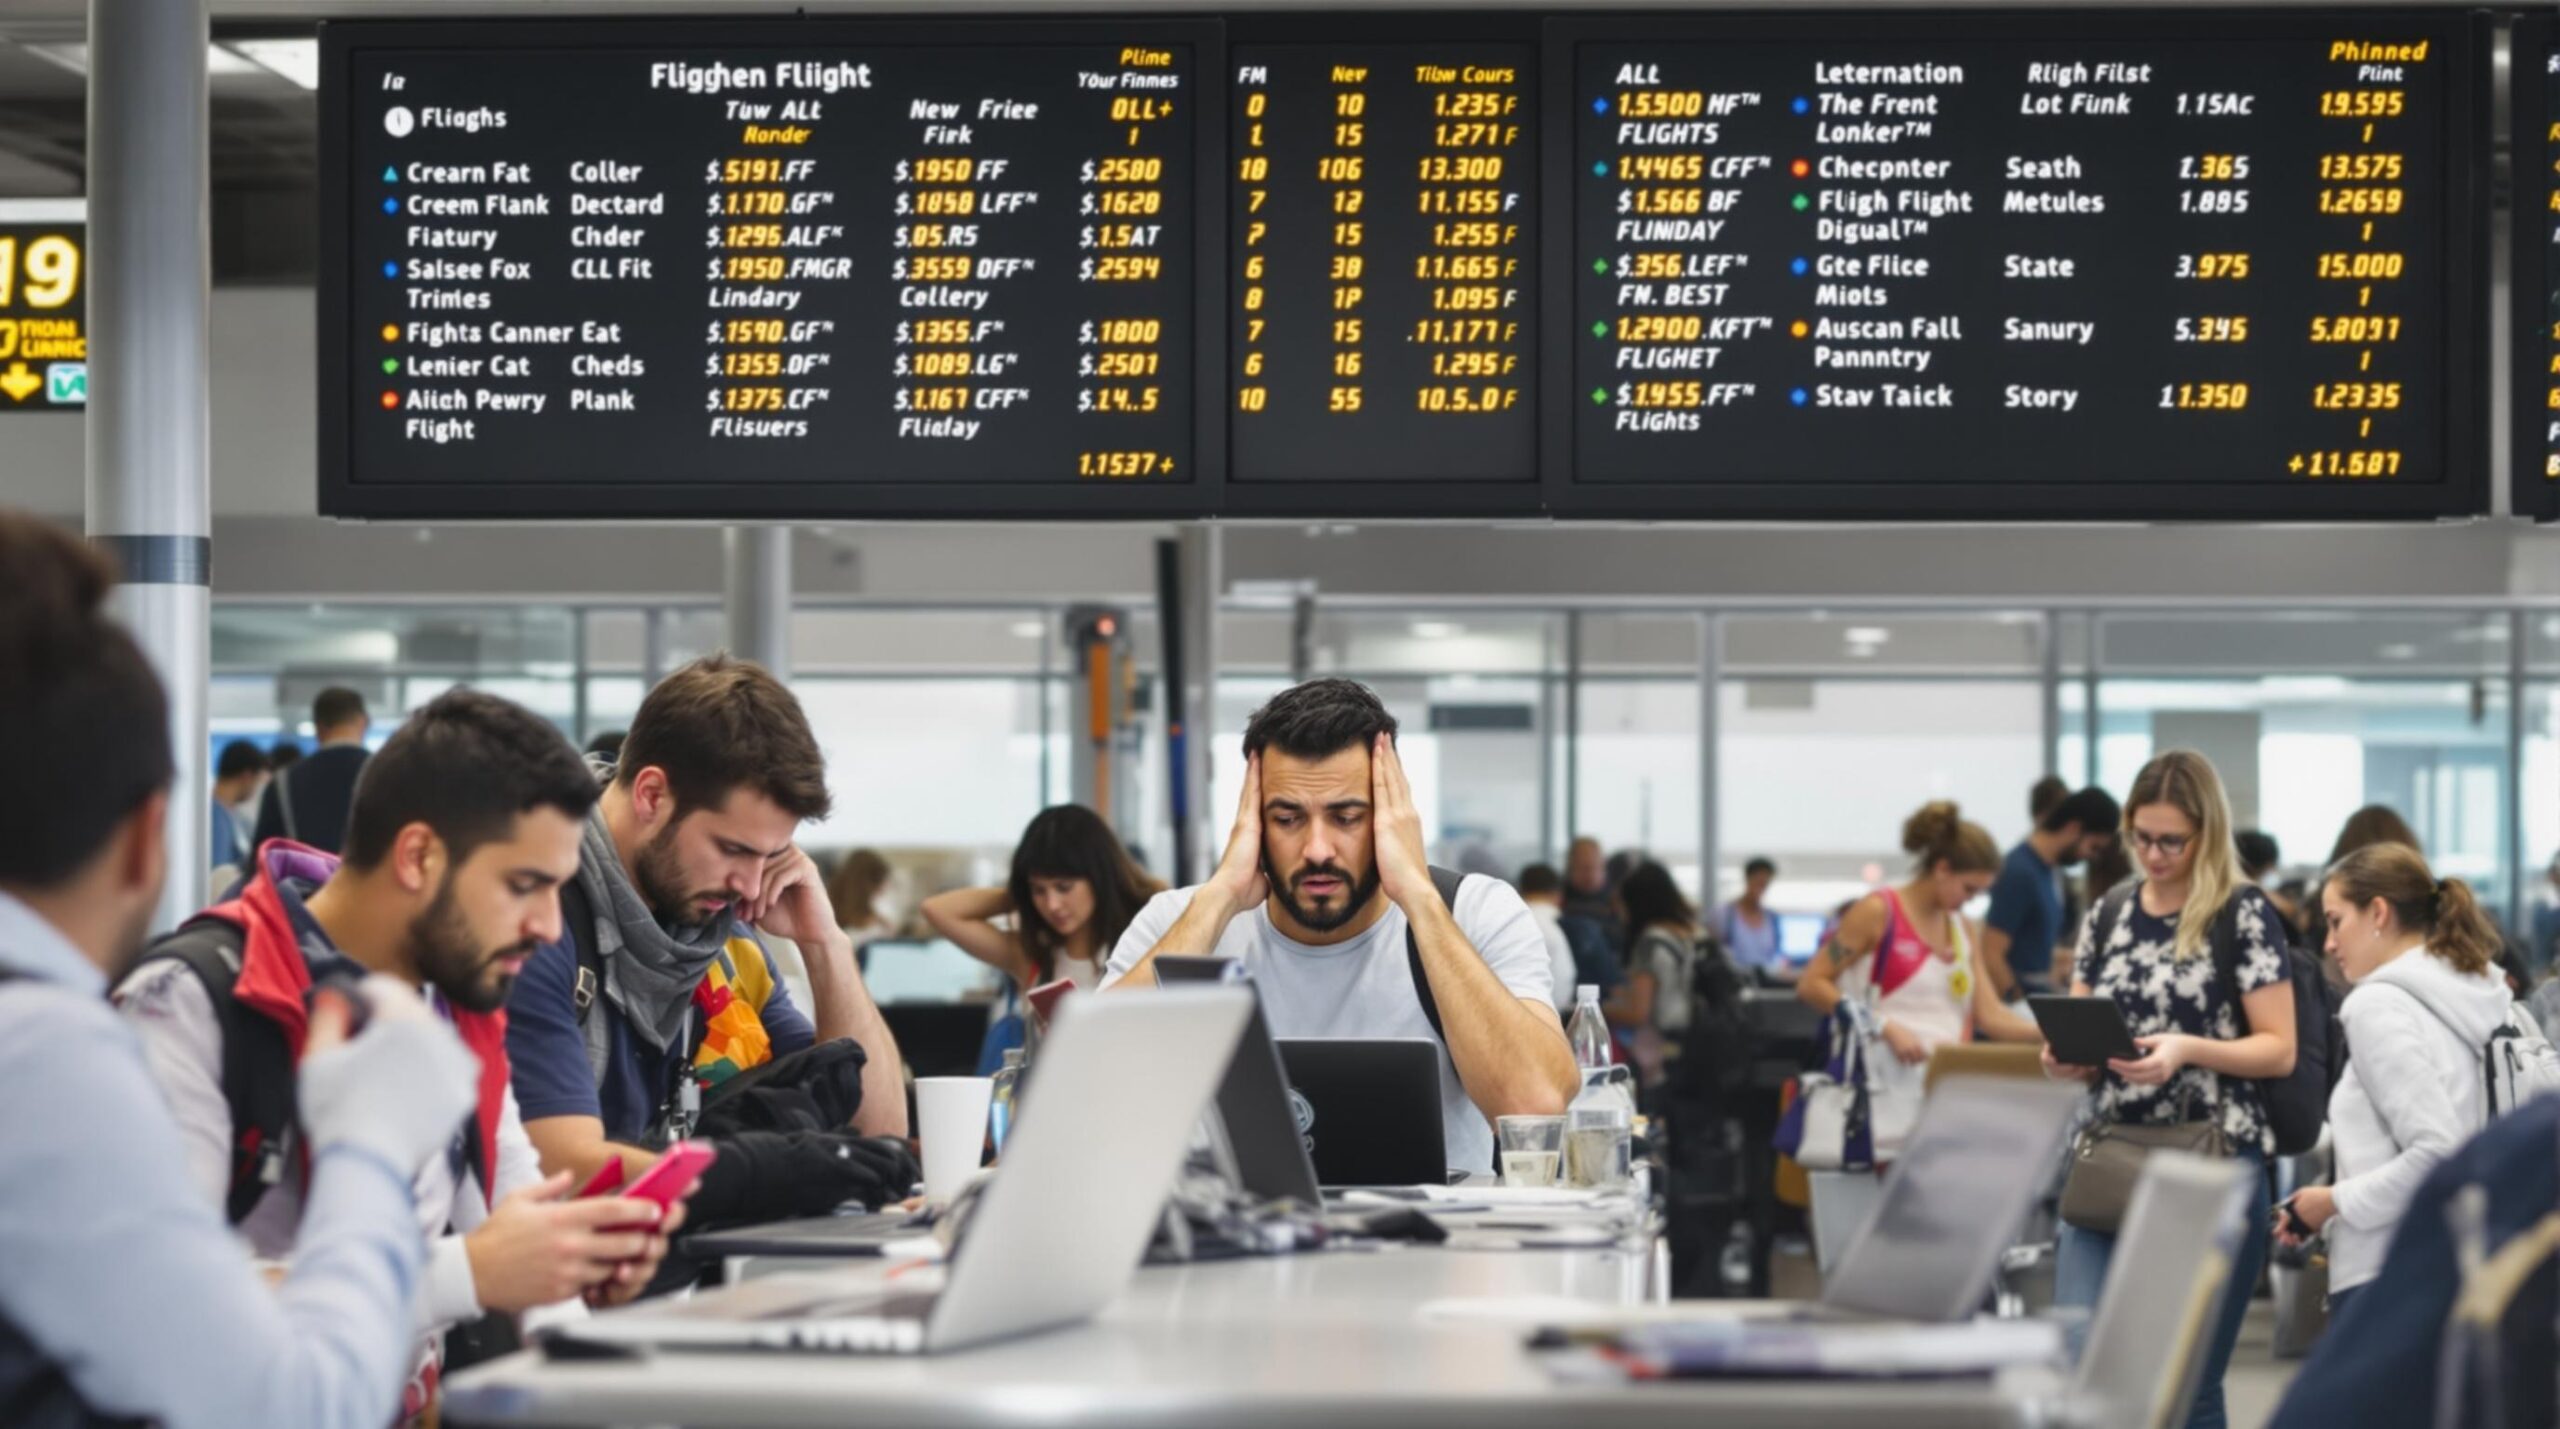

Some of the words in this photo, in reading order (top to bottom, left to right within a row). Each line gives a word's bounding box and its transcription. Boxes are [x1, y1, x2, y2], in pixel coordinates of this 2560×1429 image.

[2329, 40, 2429, 62] Phinned
[1238, 66, 1267, 84] FM
[1461, 65, 1514, 84] Cours
[1815, 61, 1964, 85] Leternation
[2358, 64, 2403, 82] Plint
[909, 98, 960, 120] New
[1337, 92, 1365, 117] 10
[1435, 92, 1501, 117] 1.235
[1818, 91, 1864, 116] The
[1870, 92, 1938, 116] Frent
[2020, 92, 2063, 115] Lot
[1335, 122, 1364, 147] 15
[1436, 122, 1499, 147] 1.271
[1617, 122, 1720, 145] FLIGHTS
[492, 161, 531, 184] Fat
[570, 159, 643, 183] Coller
[975, 159, 1009, 181] FF
[1318, 156, 1364, 182] 106
[1419, 156, 1503, 182] 13.300
[1818, 155, 1951, 182] Checpnter
[2005, 154, 2082, 180] Seath
[2320, 153, 2403, 180] 13.575
[407, 194, 479, 216] Creem
[485, 193, 550, 216] Flank
[570, 192, 664, 216] Dectard
[1249, 189, 1267, 213] 7
[1503, 192, 1519, 212] F
[1897, 189, 1973, 218] Flight
[2002, 189, 2105, 214] Metules
[407, 225, 498, 252] Fiatury
[570, 224, 645, 248] Chder
[1334, 222, 1363, 247] 15
[1434, 221, 1500, 248] 1.255
[407, 257, 484, 280] Salsee
[489, 257, 531, 280] Fox
[570, 257, 613, 280] CLL
[618, 257, 652, 279] Fit
[1245, 255, 1264, 280] 6
[1816, 253, 1862, 277] Gte
[2004, 254, 2075, 278] State
[2174, 253, 2250, 279] 3.975
[2318, 252, 2404, 279] 15.000
[1433, 285, 1500, 311] 1.095
[1503, 289, 1517, 308] F
[1663, 283, 1730, 307] BEST
[407, 321, 482, 348] Fights
[489, 321, 575, 344] Canner
[581, 320, 621, 344] Eat
[1248, 318, 1265, 342] 7
[1333, 318, 1362, 344] 15
[1814, 316, 1904, 340] Auscan
[1910, 315, 1962, 340] Fall
[2004, 316, 2095, 345] Sanury
[407, 355, 484, 377] Lenier
[489, 354, 531, 377] Cat
[571, 353, 645, 377] Cheds
[1244, 352, 1264, 377] 6
[1334, 351, 1362, 377] 16
[1433, 351, 1500, 377] 1.295
[1615, 346, 1722, 370] FLIGHET
[1814, 344, 1932, 373] Pannntry
[475, 388, 547, 414] Pewry
[570, 388, 635, 411] Plank
[1239, 386, 1267, 412] 10
[1329, 386, 1362, 412] 55
[1815, 383, 1874, 407] Stav
[1881, 383, 1953, 407] Taick
[2004, 384, 2079, 412] Story
[405, 417, 475, 444] Flight
